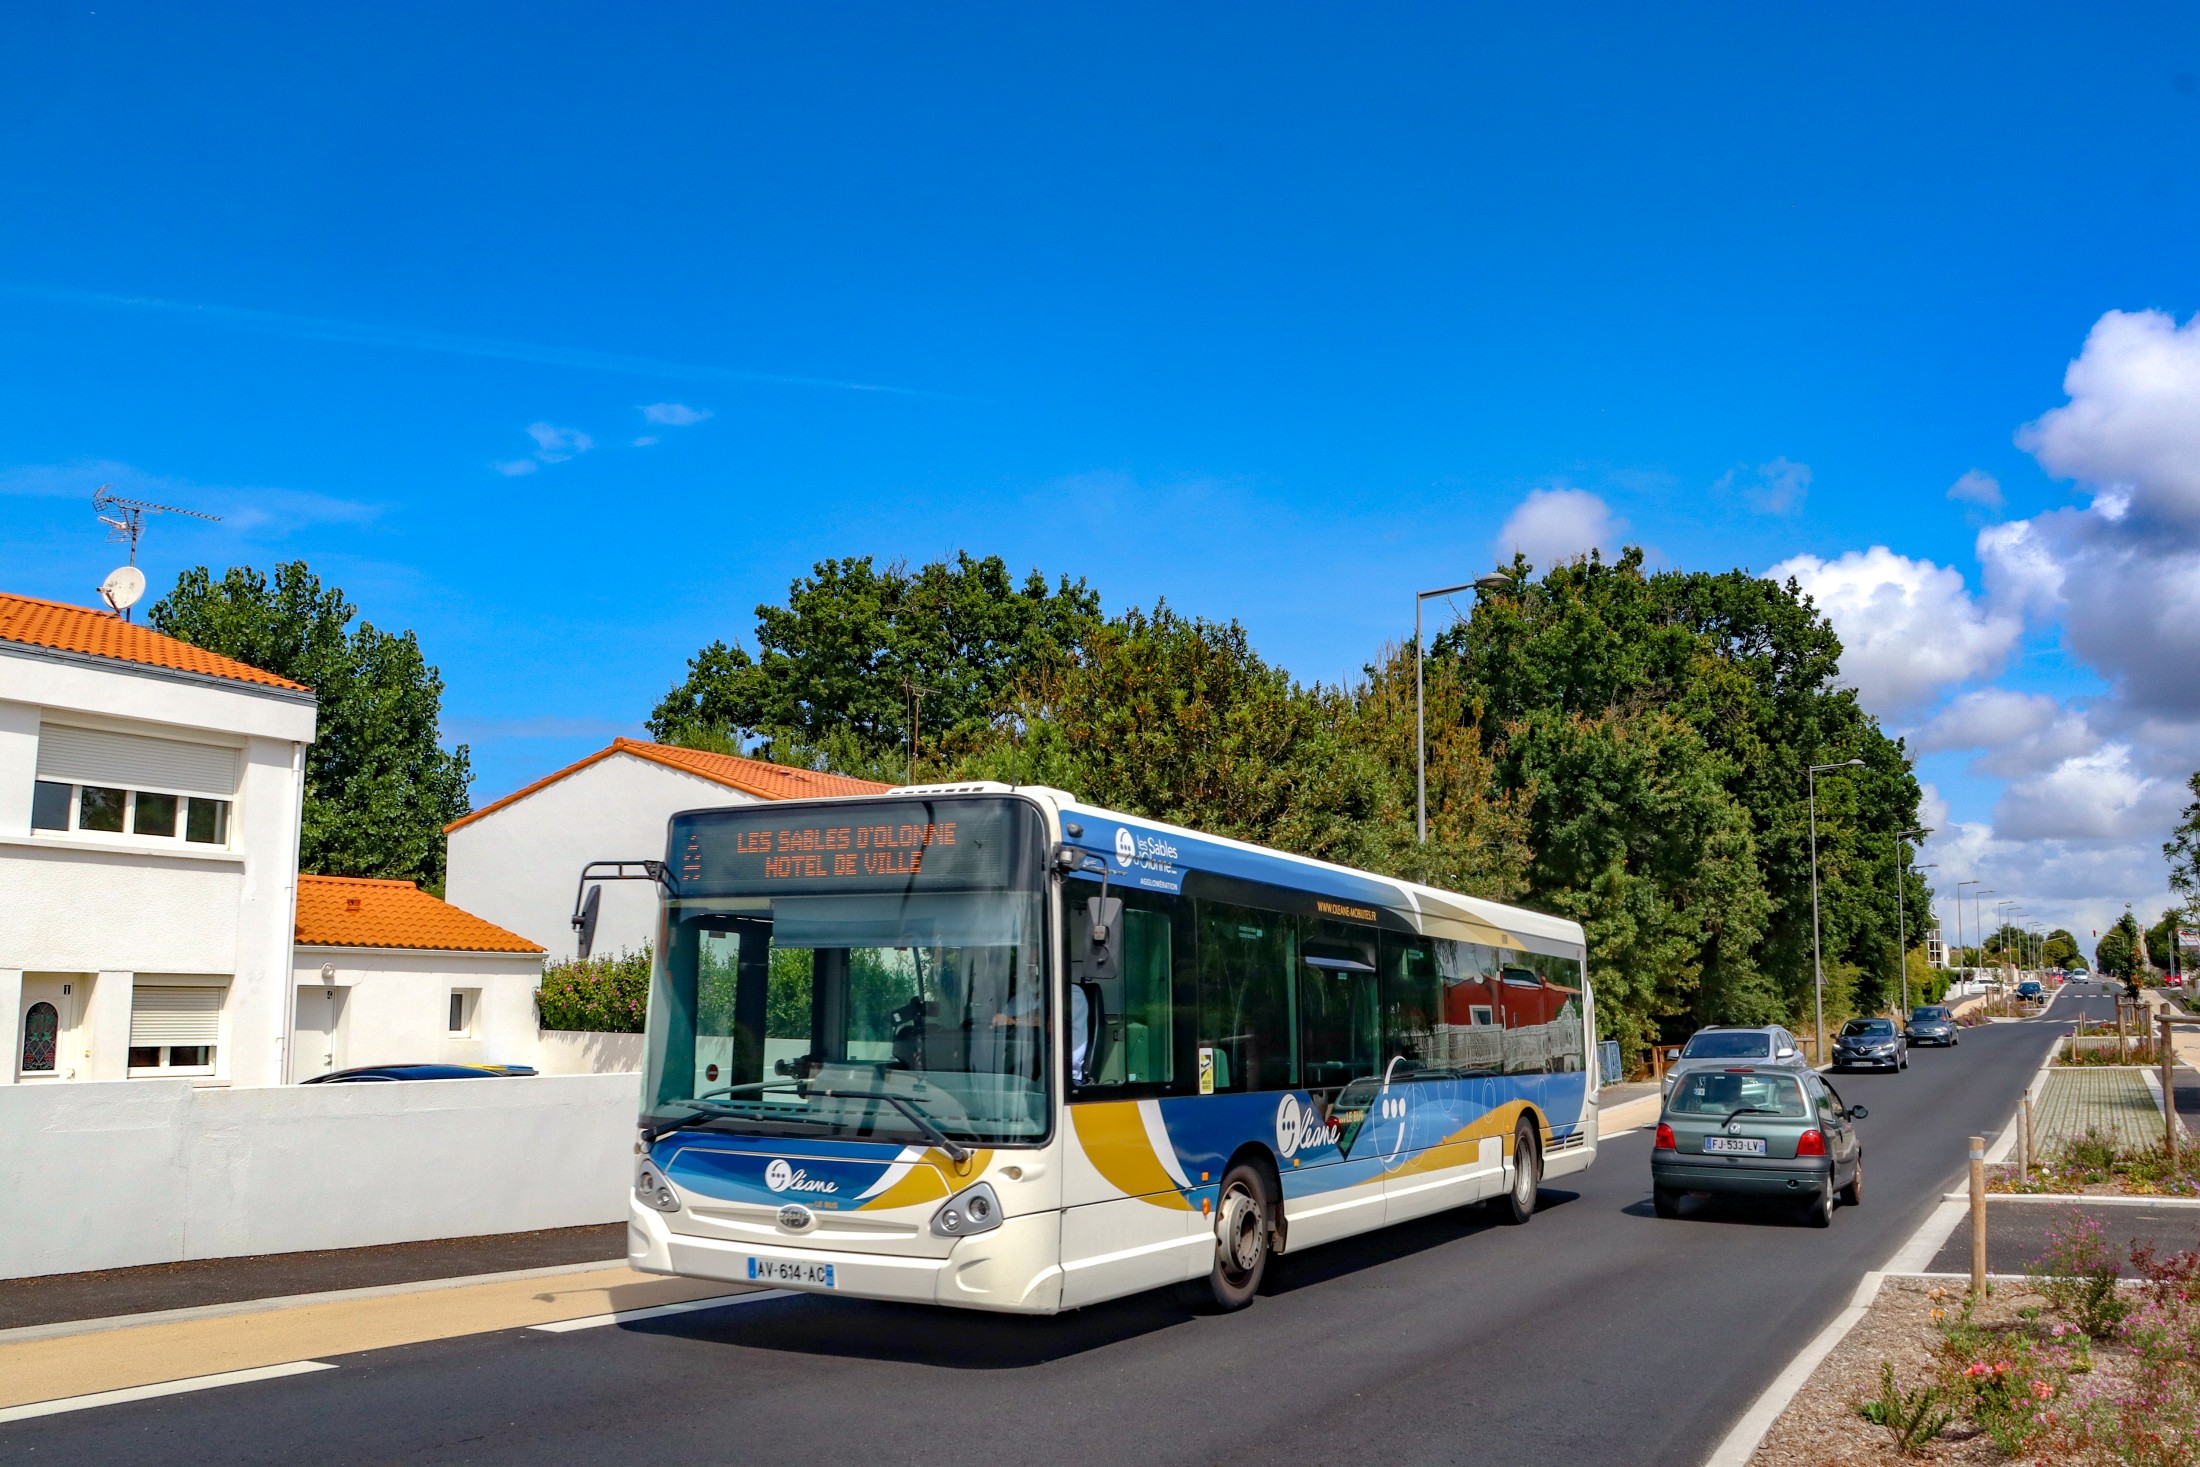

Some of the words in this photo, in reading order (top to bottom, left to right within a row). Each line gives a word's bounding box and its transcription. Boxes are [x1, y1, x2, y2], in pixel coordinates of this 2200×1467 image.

[737, 831, 772, 853] LES
[778, 827, 851, 851] SABLES
[857, 823, 956, 847] D'OLONNE
[1136, 834, 1148, 851] les
[1147, 837, 1178, 859] Sables
[765, 855, 828, 878] HOTEL
[834, 854, 858, 875] DE
[864, 851, 923, 874] VILLE
[1712, 1139, 1758, 1151] FJ-533-LV
[757, 1261, 825, 1282] AV-614-AC
